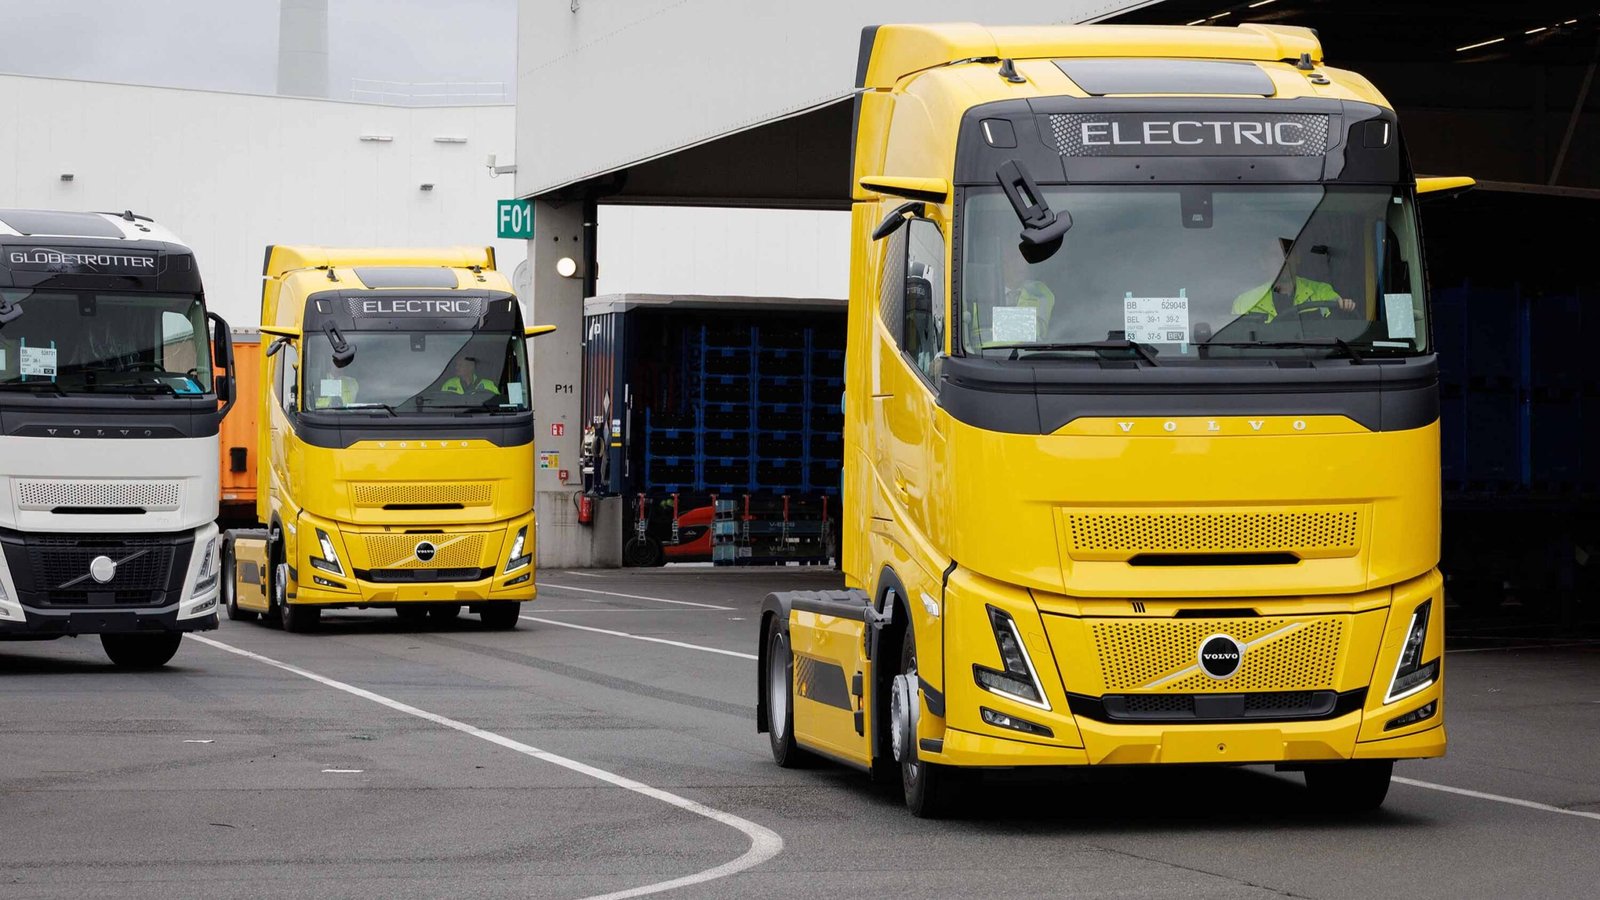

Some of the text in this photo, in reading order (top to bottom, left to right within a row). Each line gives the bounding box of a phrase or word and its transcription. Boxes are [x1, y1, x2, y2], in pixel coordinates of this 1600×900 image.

[1081, 120, 1304, 146] ELECTRIC
[500, 204, 531, 233] F01
[10, 252, 155, 268] GLOBETROTTER
[363, 300, 471, 313] ELECTRIC
[1146, 315, 1160, 324] 39-1
[555, 384, 573, 394] P11
[47, 428, 152, 436] VOLVO
[1118, 420, 1306, 432] VOLVO
[379, 440, 469, 448] VOLVO
